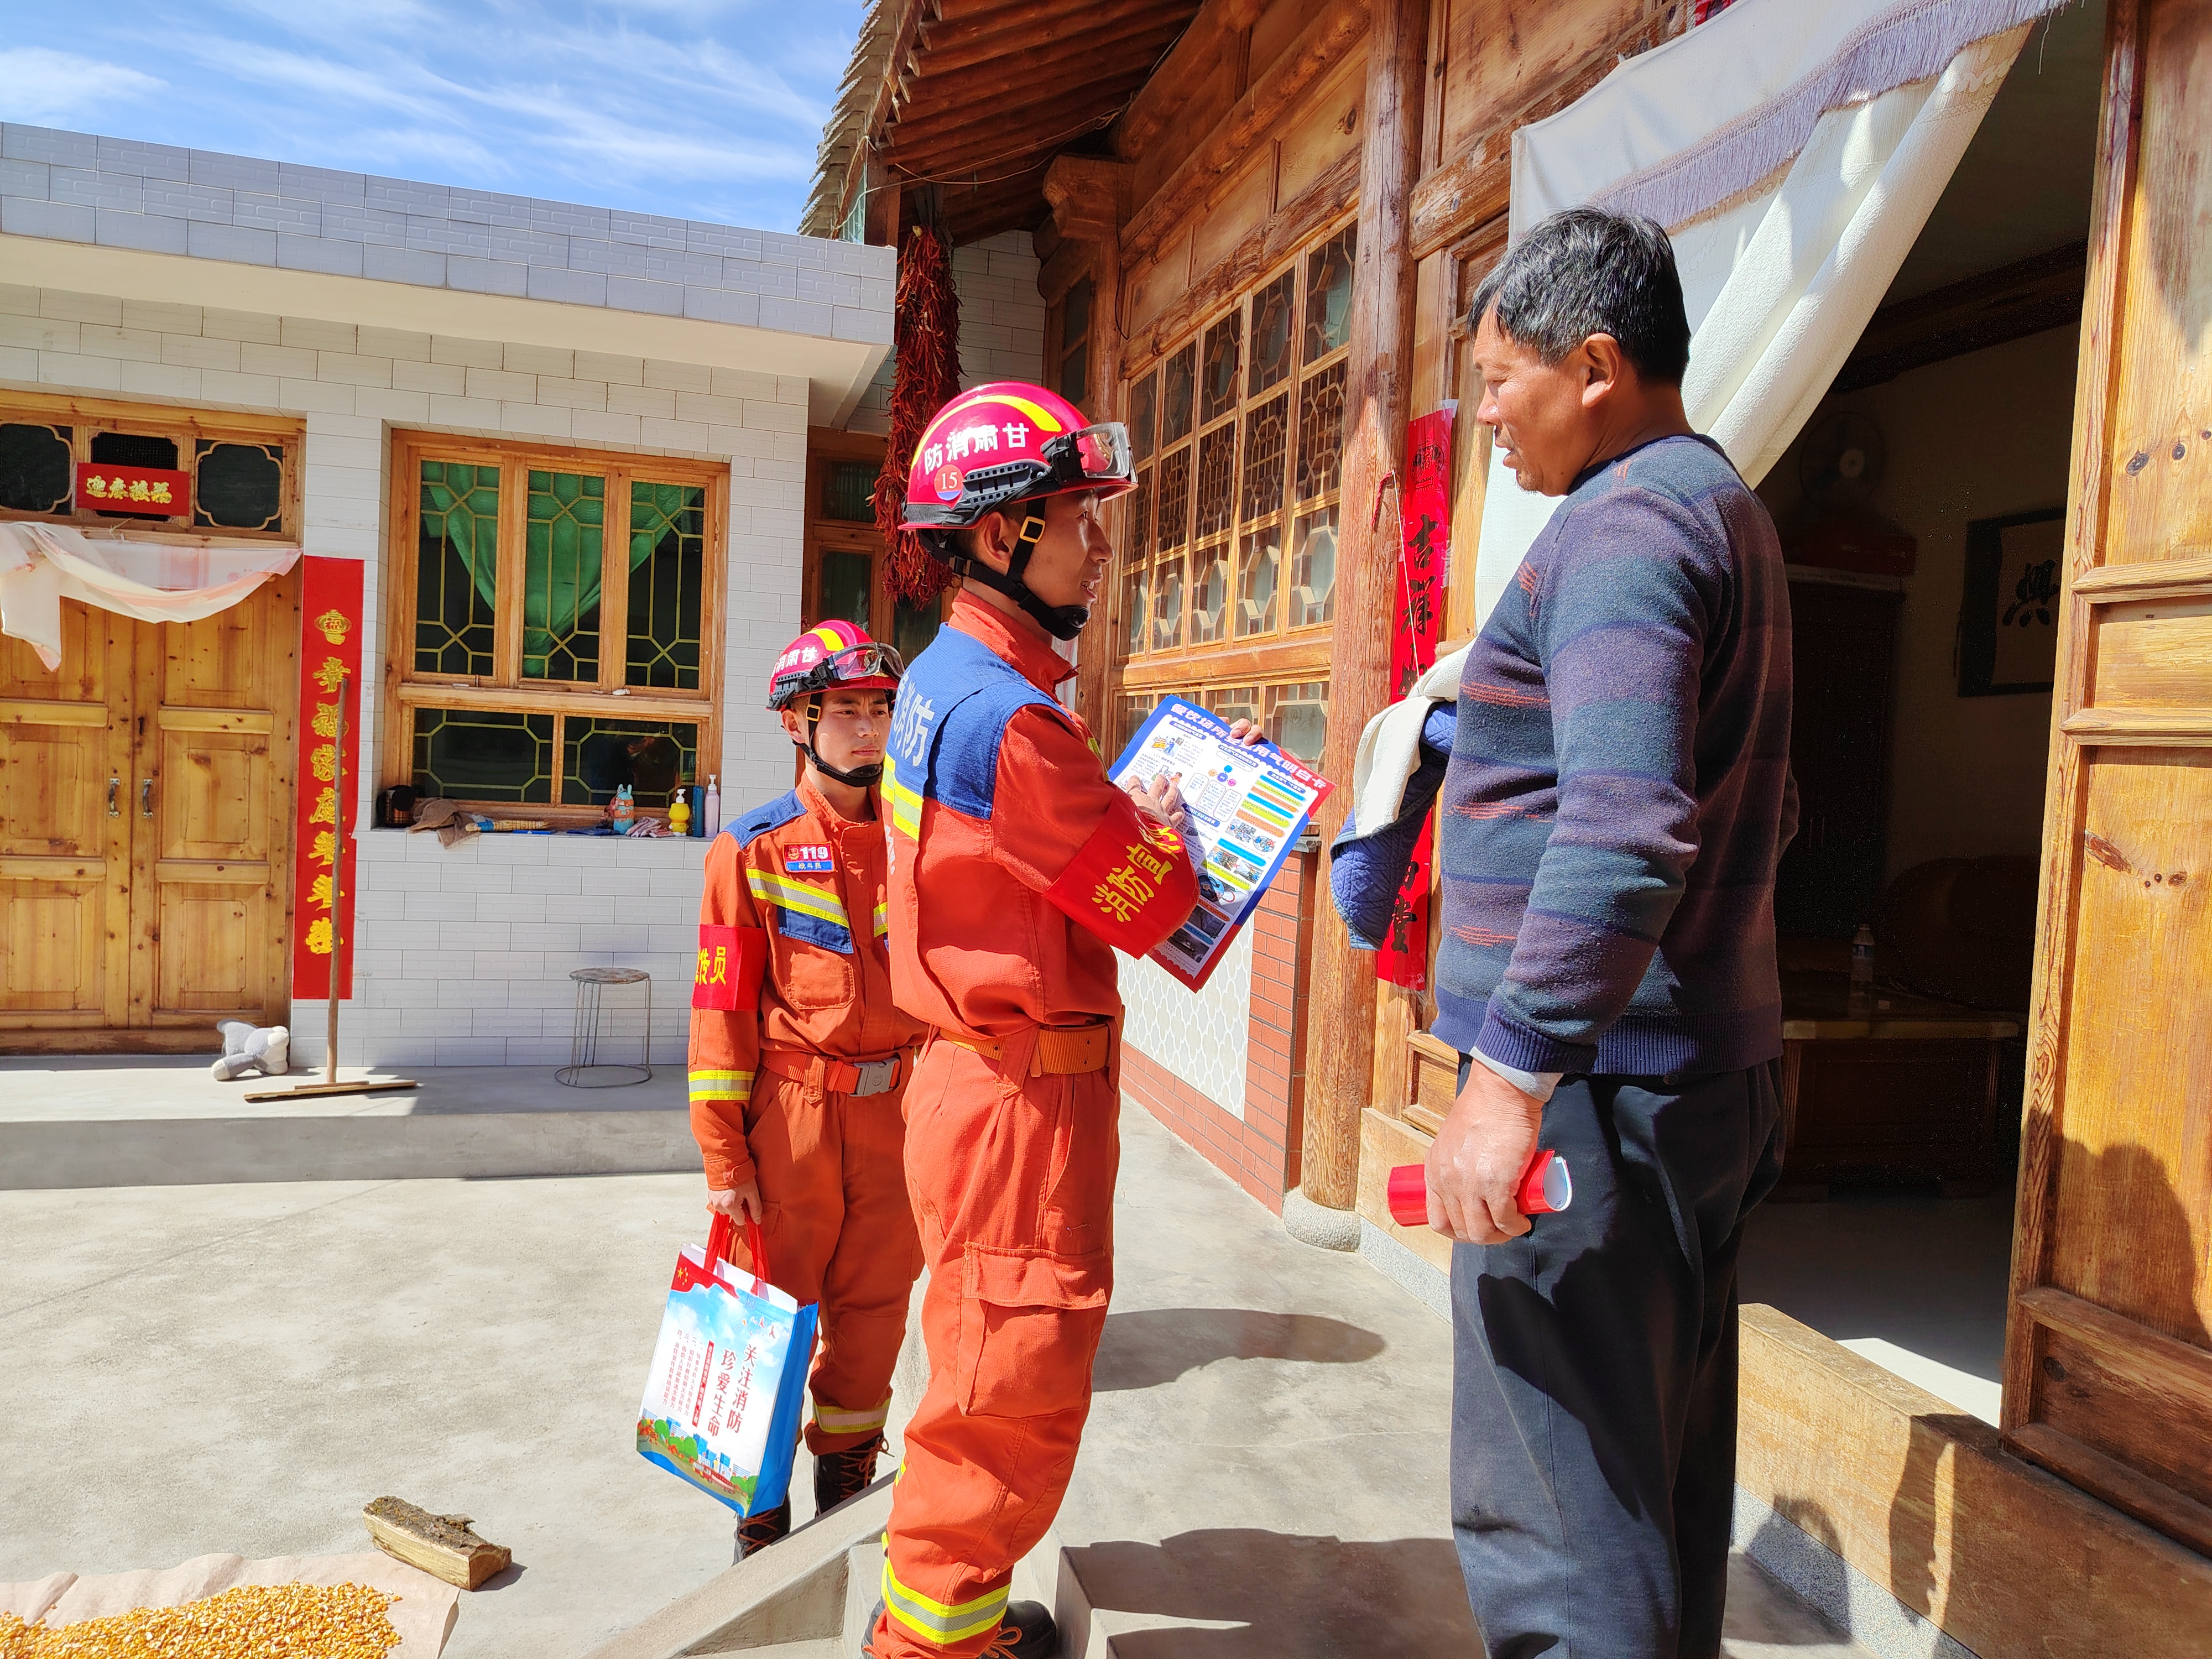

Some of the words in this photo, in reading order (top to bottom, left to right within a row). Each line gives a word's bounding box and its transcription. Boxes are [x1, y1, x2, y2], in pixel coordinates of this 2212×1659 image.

[86, 475, 173, 504] 迎春接福
[941, 472, 957, 489] 15
[800, 847, 828, 859] 119
[707, 1349, 736, 1437] 珍爱生命
[727, 1344, 757, 1433] 关注消防
